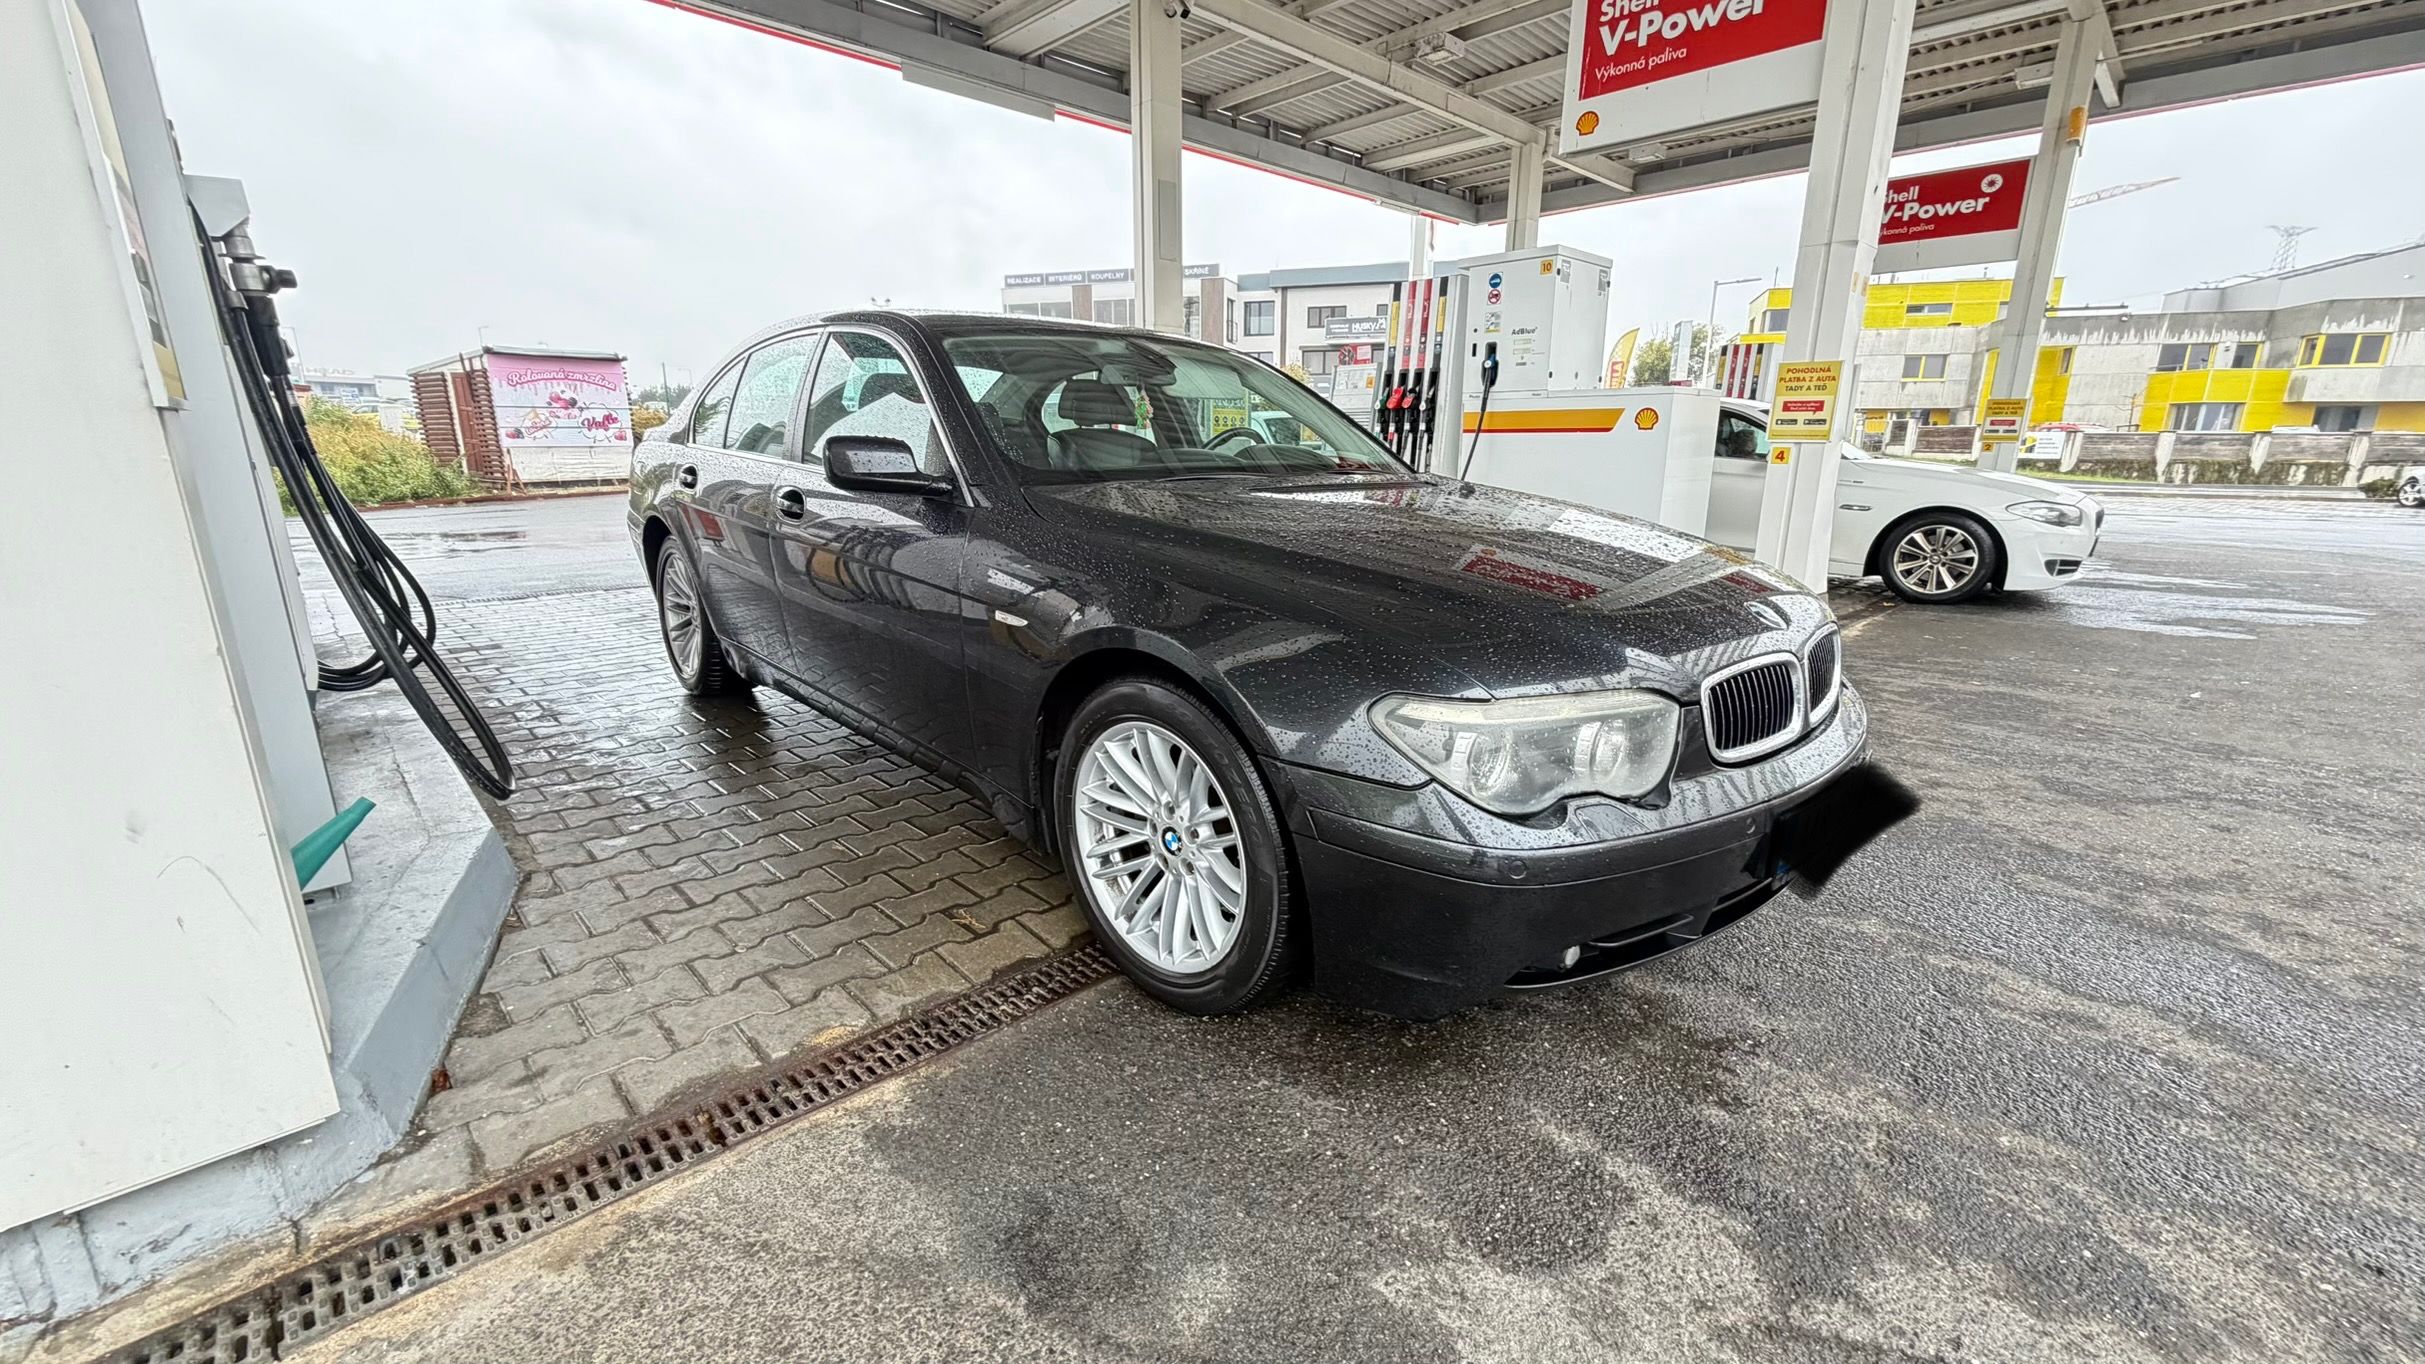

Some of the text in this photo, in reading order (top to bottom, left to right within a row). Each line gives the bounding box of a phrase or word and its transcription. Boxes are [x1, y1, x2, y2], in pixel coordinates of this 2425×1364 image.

[1595, 47, 1687, 83] Výkonná paliva
[1909, 223, 1935, 235] paliva
[1541, 262, 1552, 272] 10
[1786, 365, 1832, 375] POHODLNÁ
[508, 368, 616, 391] Rolovaná zmrzlina
[1778, 376, 1806, 384] PLATBA
[1814, 383, 1827, 391] TEĎ
[1775, 450, 1785, 462] 4
